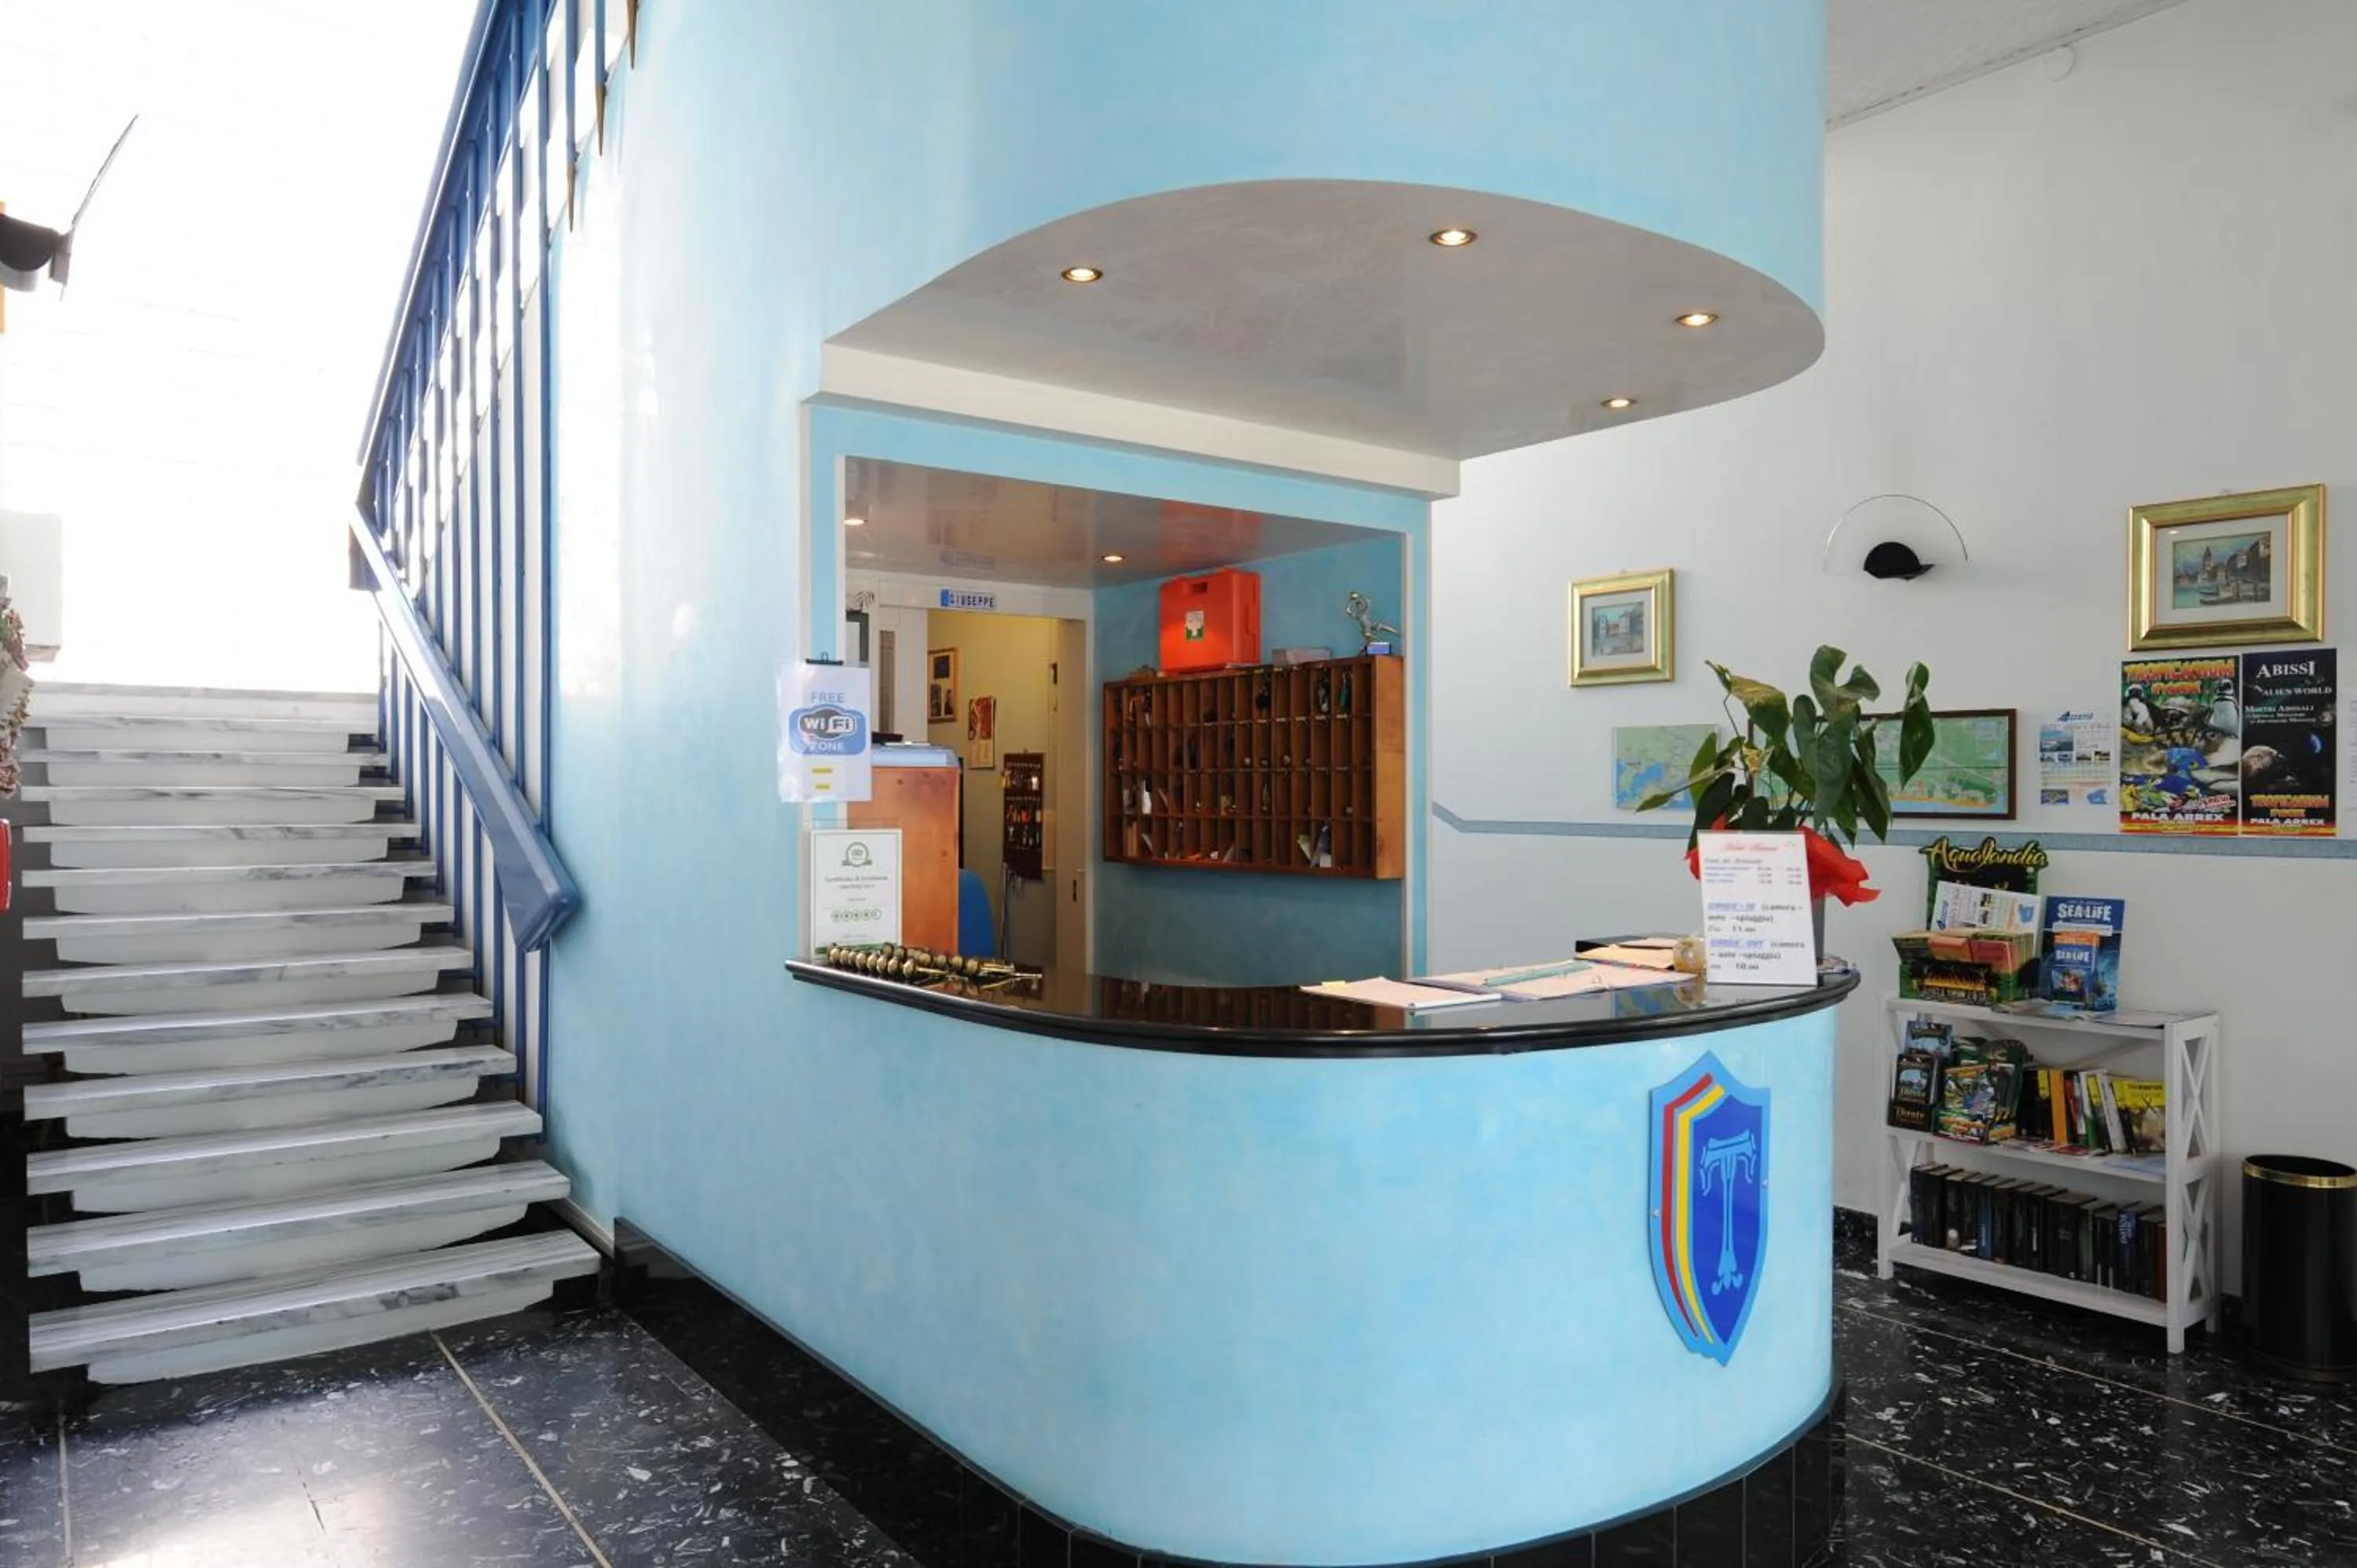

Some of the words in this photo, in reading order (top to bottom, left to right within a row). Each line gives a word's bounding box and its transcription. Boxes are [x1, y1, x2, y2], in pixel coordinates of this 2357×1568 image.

[2256, 661, 2315, 678] ABISSI
[811, 691, 845, 703] FREE
[2131, 811, 2169, 820] PALA
[1926, 837, 2046, 874] Aqualandia
[2057, 903, 2083, 918] SEA
